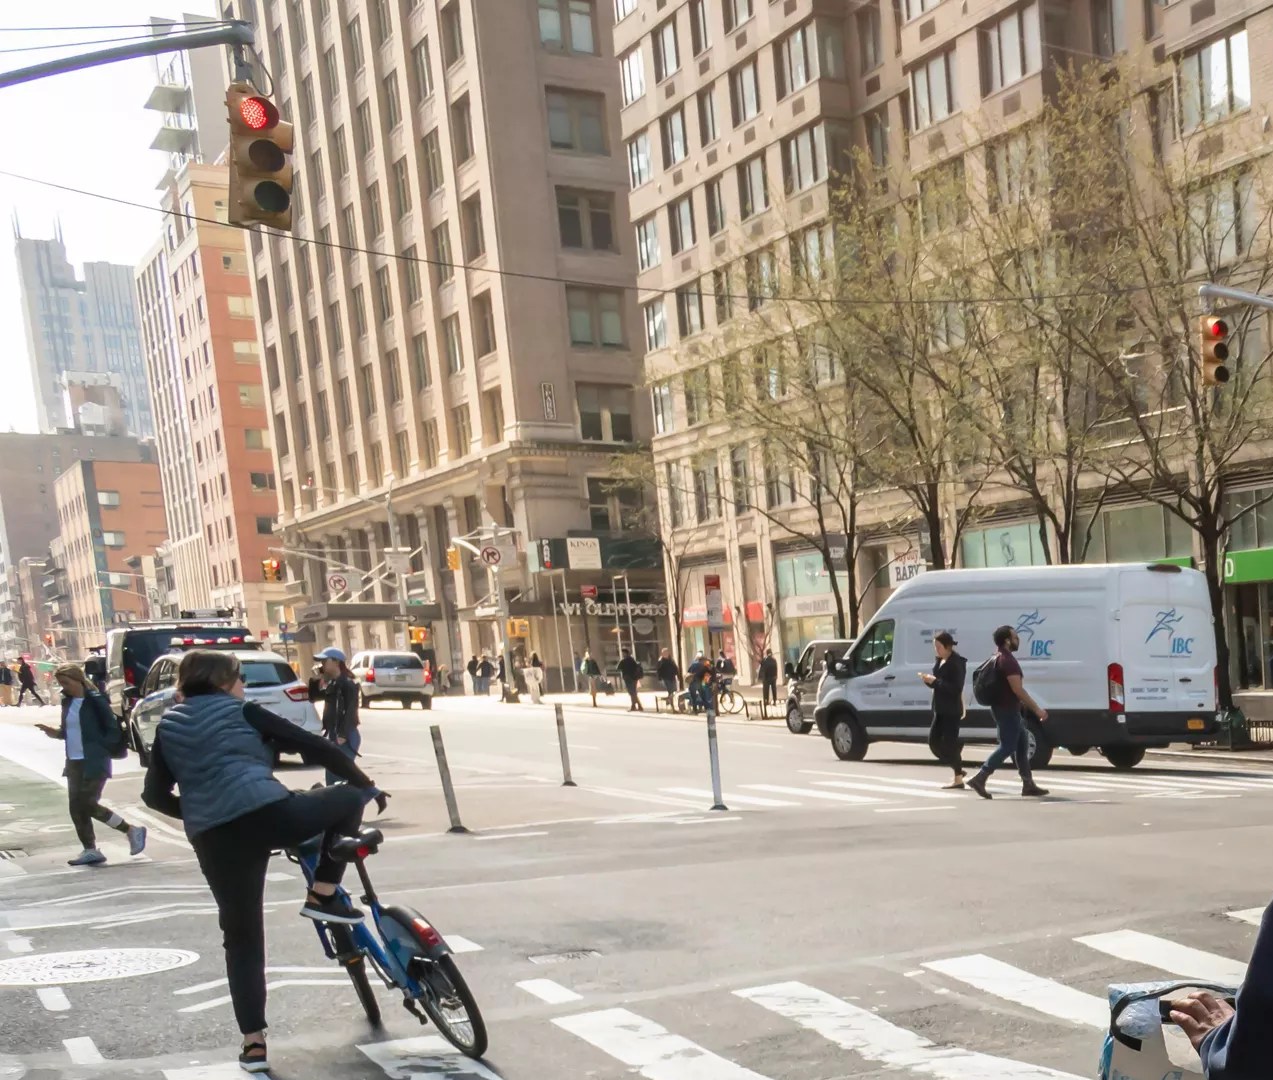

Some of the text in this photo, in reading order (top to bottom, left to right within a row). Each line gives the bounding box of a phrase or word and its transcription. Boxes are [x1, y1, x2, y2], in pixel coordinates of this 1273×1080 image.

[570, 540, 598, 549] KINGS
[895, 563, 920, 582] BABY
[619, 602, 668, 616] FOODS
[1031, 639, 1054, 656] IBC
[1171, 637, 1194, 654] IBC
